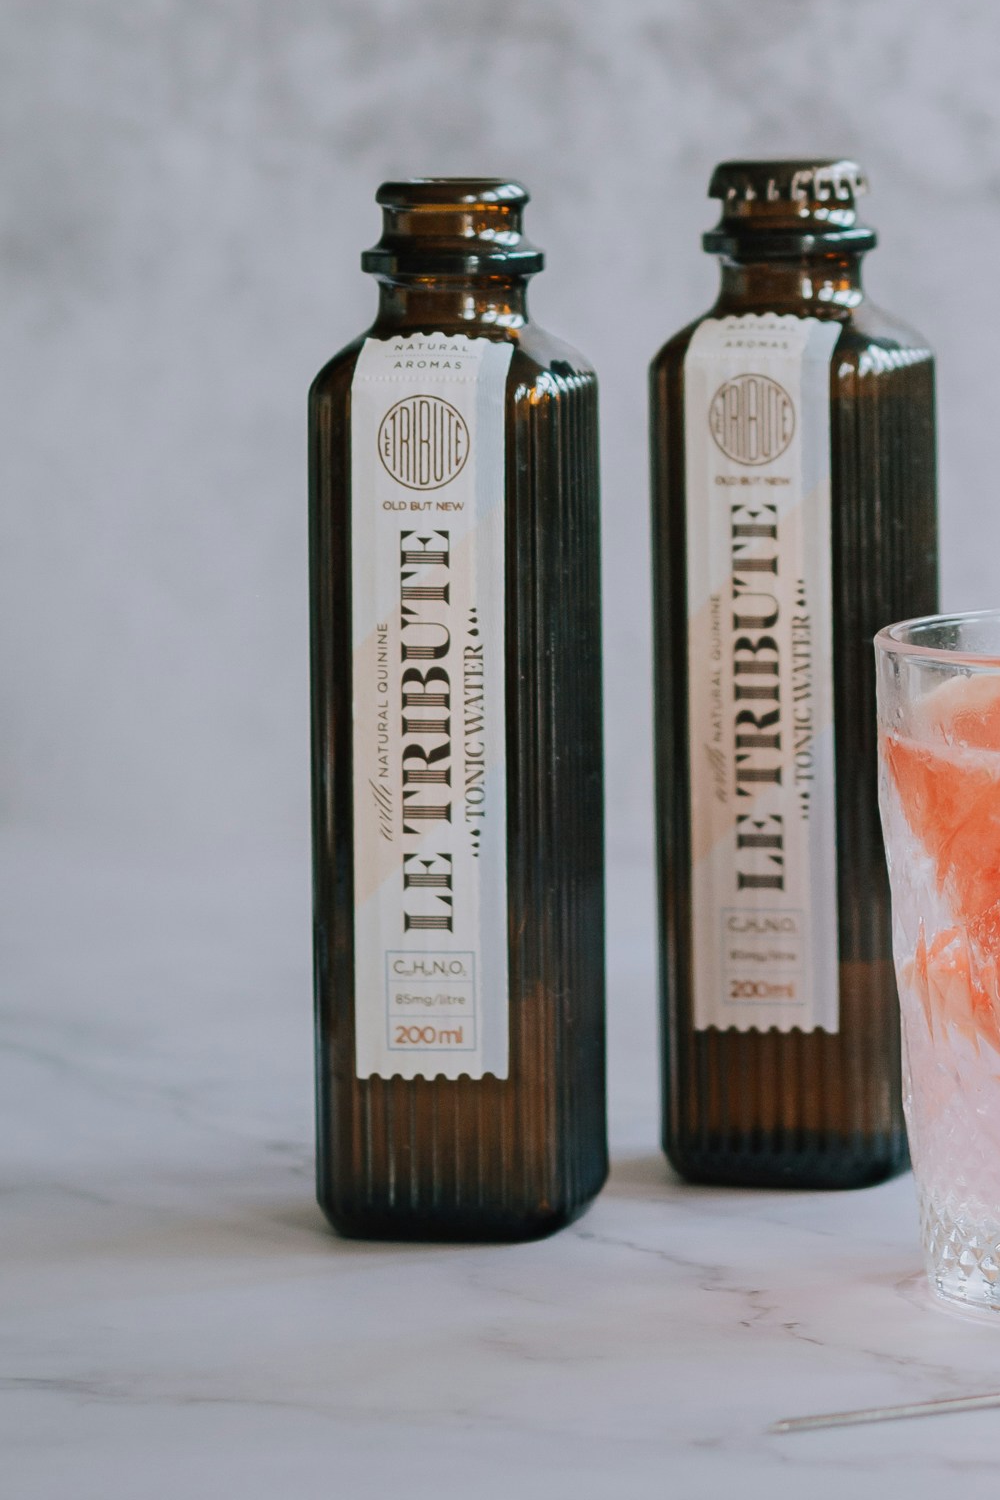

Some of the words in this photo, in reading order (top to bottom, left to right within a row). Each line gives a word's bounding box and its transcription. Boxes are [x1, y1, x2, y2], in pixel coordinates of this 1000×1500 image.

[394, 342, 469, 352] NATURAL
[394, 360, 463, 370] AROMAS
[389, 400, 463, 486] TRIBUTE
[382, 501, 407, 511] OLD
[410, 501, 432, 511] BUT
[436, 501, 465, 511] NEW
[376, 622, 389, 694] QUININE
[400, 529, 452, 835] TRIBUTE
[463, 644, 485, 736] WATER
[731, 504, 783, 798] TRIBUTE
[792, 615, 813, 703] WATER
[376, 700, 389, 778] NATURAL
[795, 707, 815, 785] TONIC
[464, 741, 485, 823] TONIC
[403, 852, 453, 934] LE
[736, 814, 786, 892] LE
